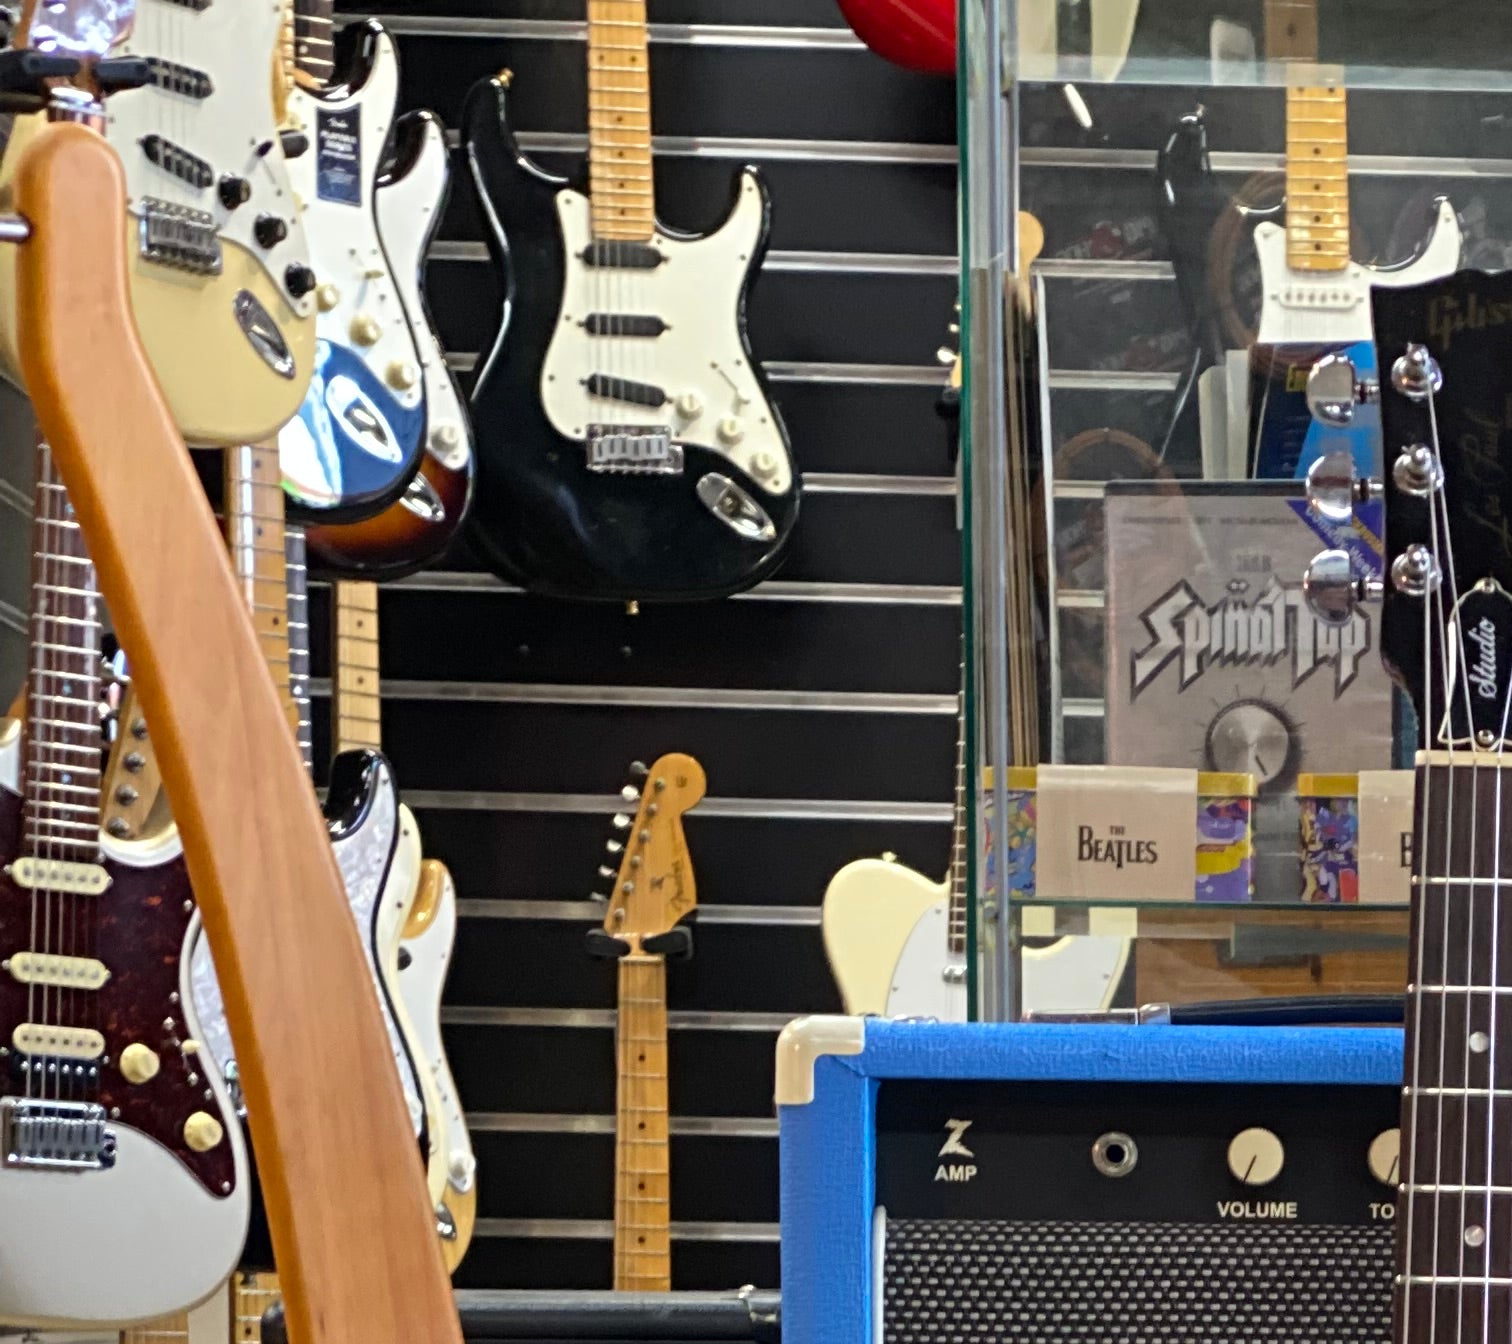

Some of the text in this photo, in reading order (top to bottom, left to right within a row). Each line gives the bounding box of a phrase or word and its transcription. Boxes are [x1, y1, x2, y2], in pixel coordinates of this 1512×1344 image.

[1468, 616, 1497, 699] Studio
[1077, 825, 1158, 869] BEATLES
[934, 1164, 978, 1182] AMP
[1217, 1201, 1298, 1219] VOLUME
[1368, 1203, 1395, 1220] TO
